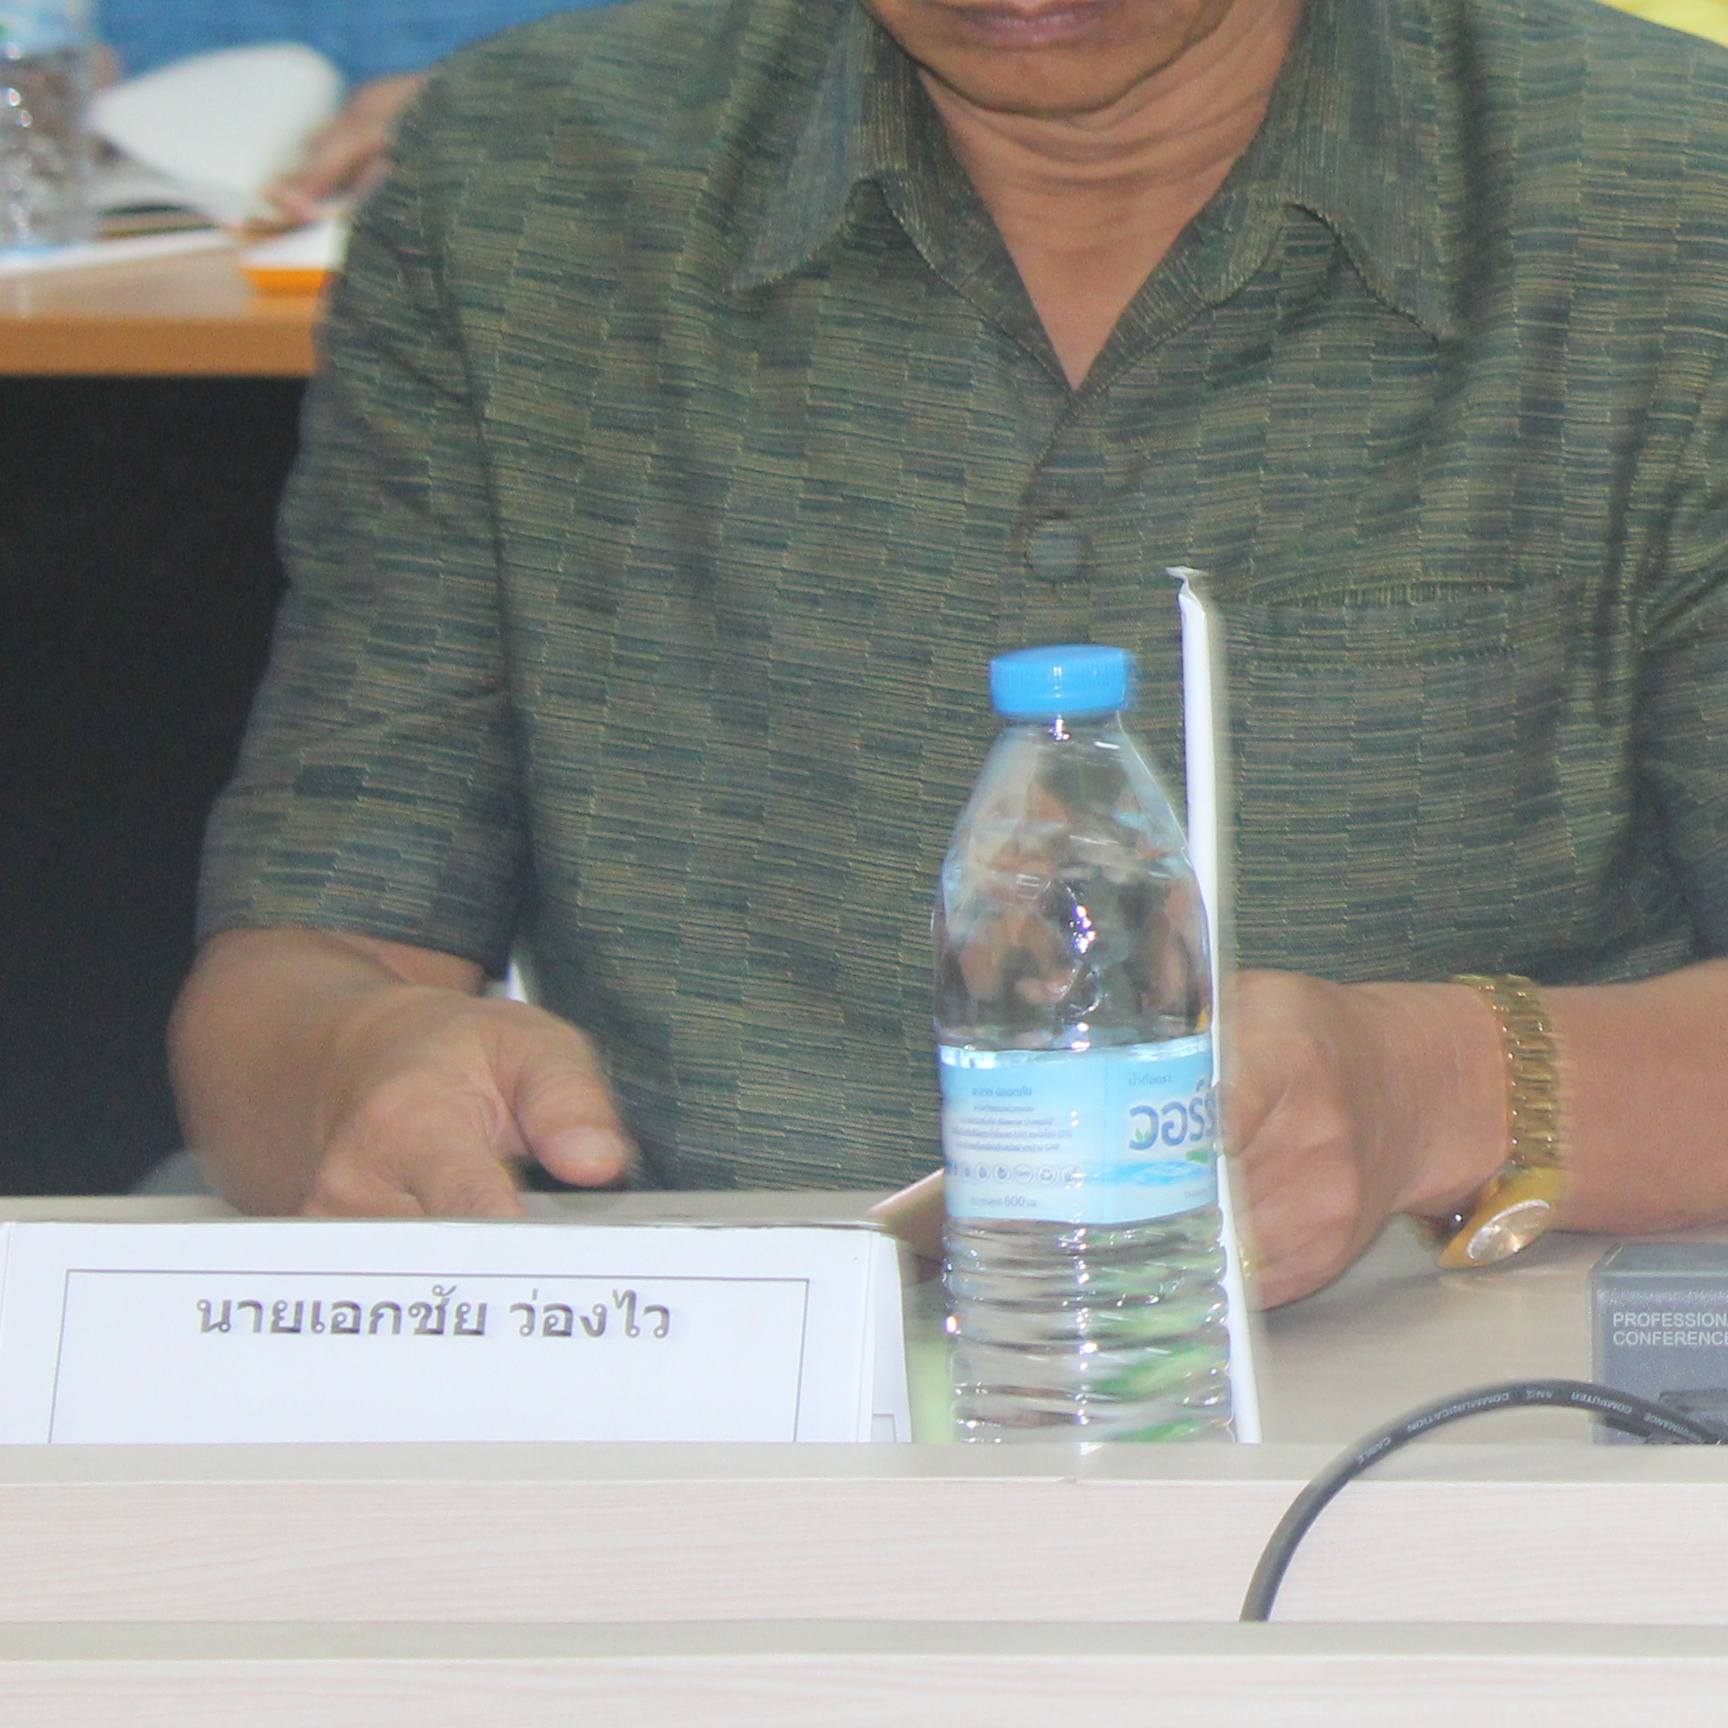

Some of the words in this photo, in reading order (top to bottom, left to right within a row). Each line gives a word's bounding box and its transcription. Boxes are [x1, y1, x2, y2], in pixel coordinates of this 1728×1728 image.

[195, 1283, 490, 1338] นายเอกชัย
[508, 1287, 672, 1340] ว่องไว
[1406, 1391, 1510, 1433] COMMUNICATION
[1570, 1391, 1633, 1415] COMPUTER
[1355, 1436, 1392, 1465] CABLE
